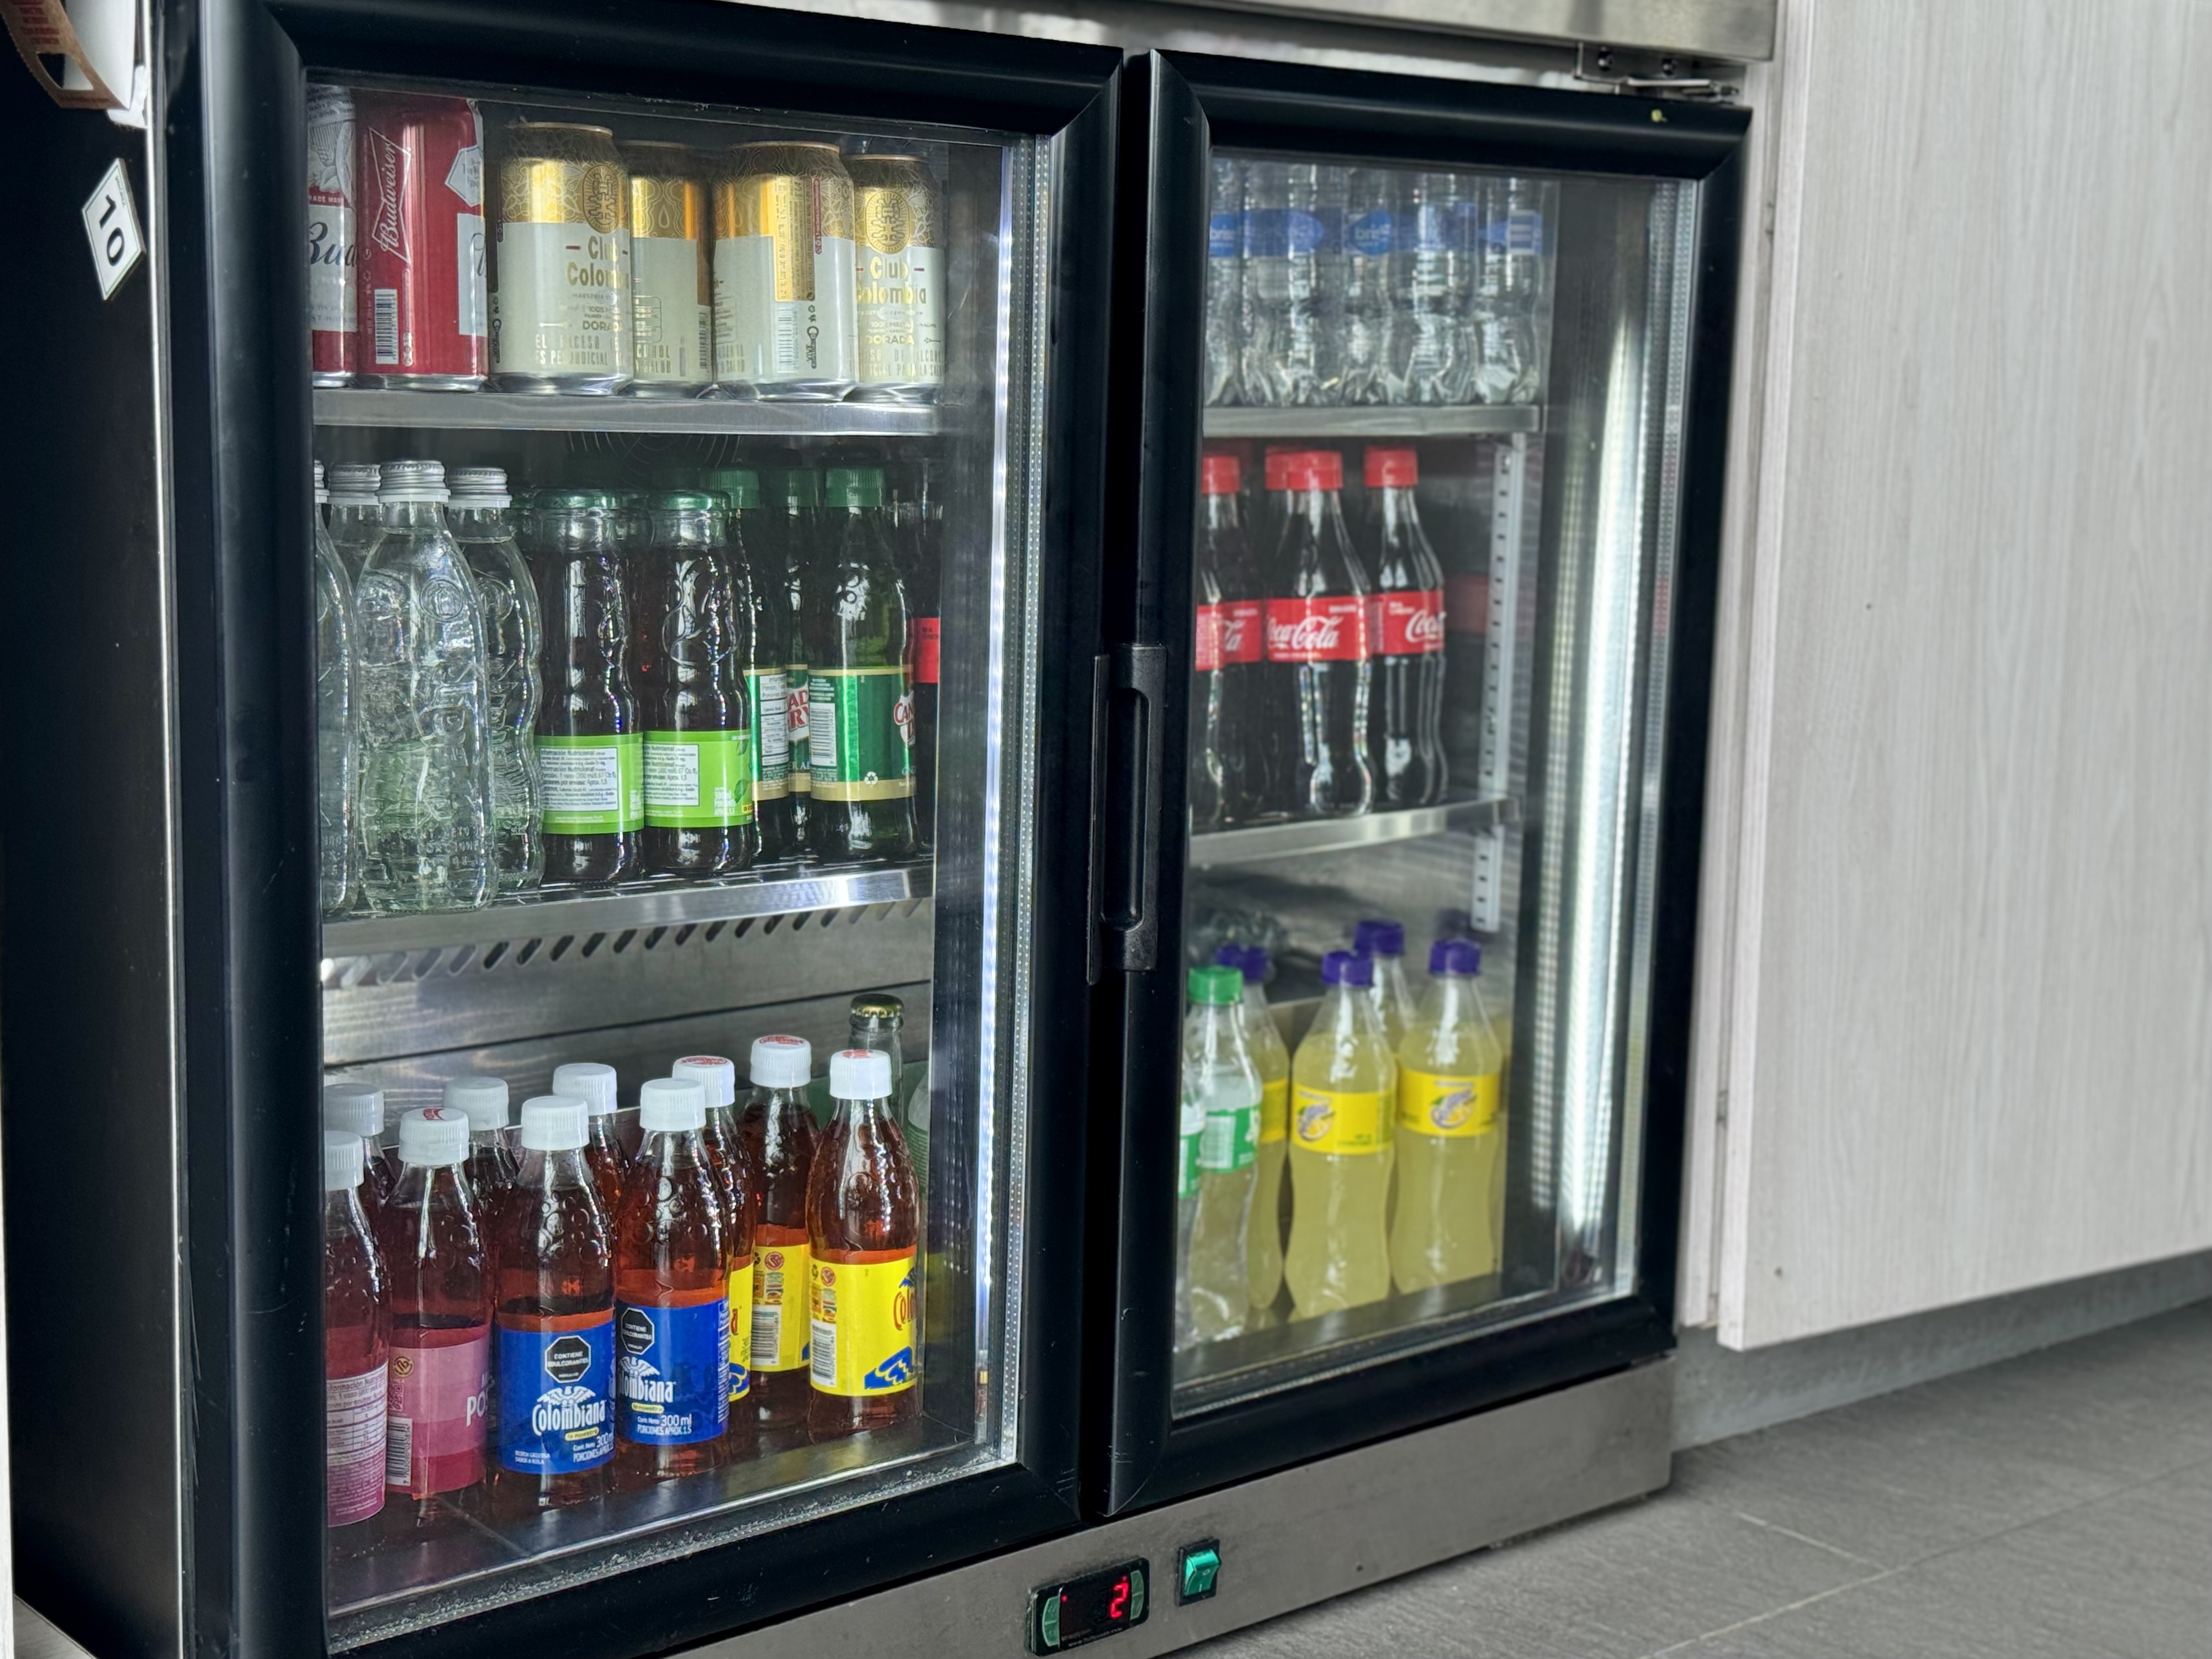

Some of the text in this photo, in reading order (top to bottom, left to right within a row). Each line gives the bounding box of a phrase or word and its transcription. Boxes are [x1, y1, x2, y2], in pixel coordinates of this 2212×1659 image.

[380, 142, 399, 252] Budweiser
[99, 194, 125, 267] 10
[588, 235, 619, 262] Cl
[567, 261, 629, 290] Colo
[870, 256, 909, 280] Club
[550, 350, 608, 366] PEJUDICIAL
[554, 1350, 584, 1360] CONTIENE
[329, 1380, 363, 1392] formación
[620, 1369, 673, 1403] lombiana
[466, 1391, 488, 1428] PO
[532, 1399, 606, 1437] Colombiana
[661, 1414, 680, 1427] 300
[680, 1413, 692, 1426] ml
[1109, 1582, 1129, 1619] 2
